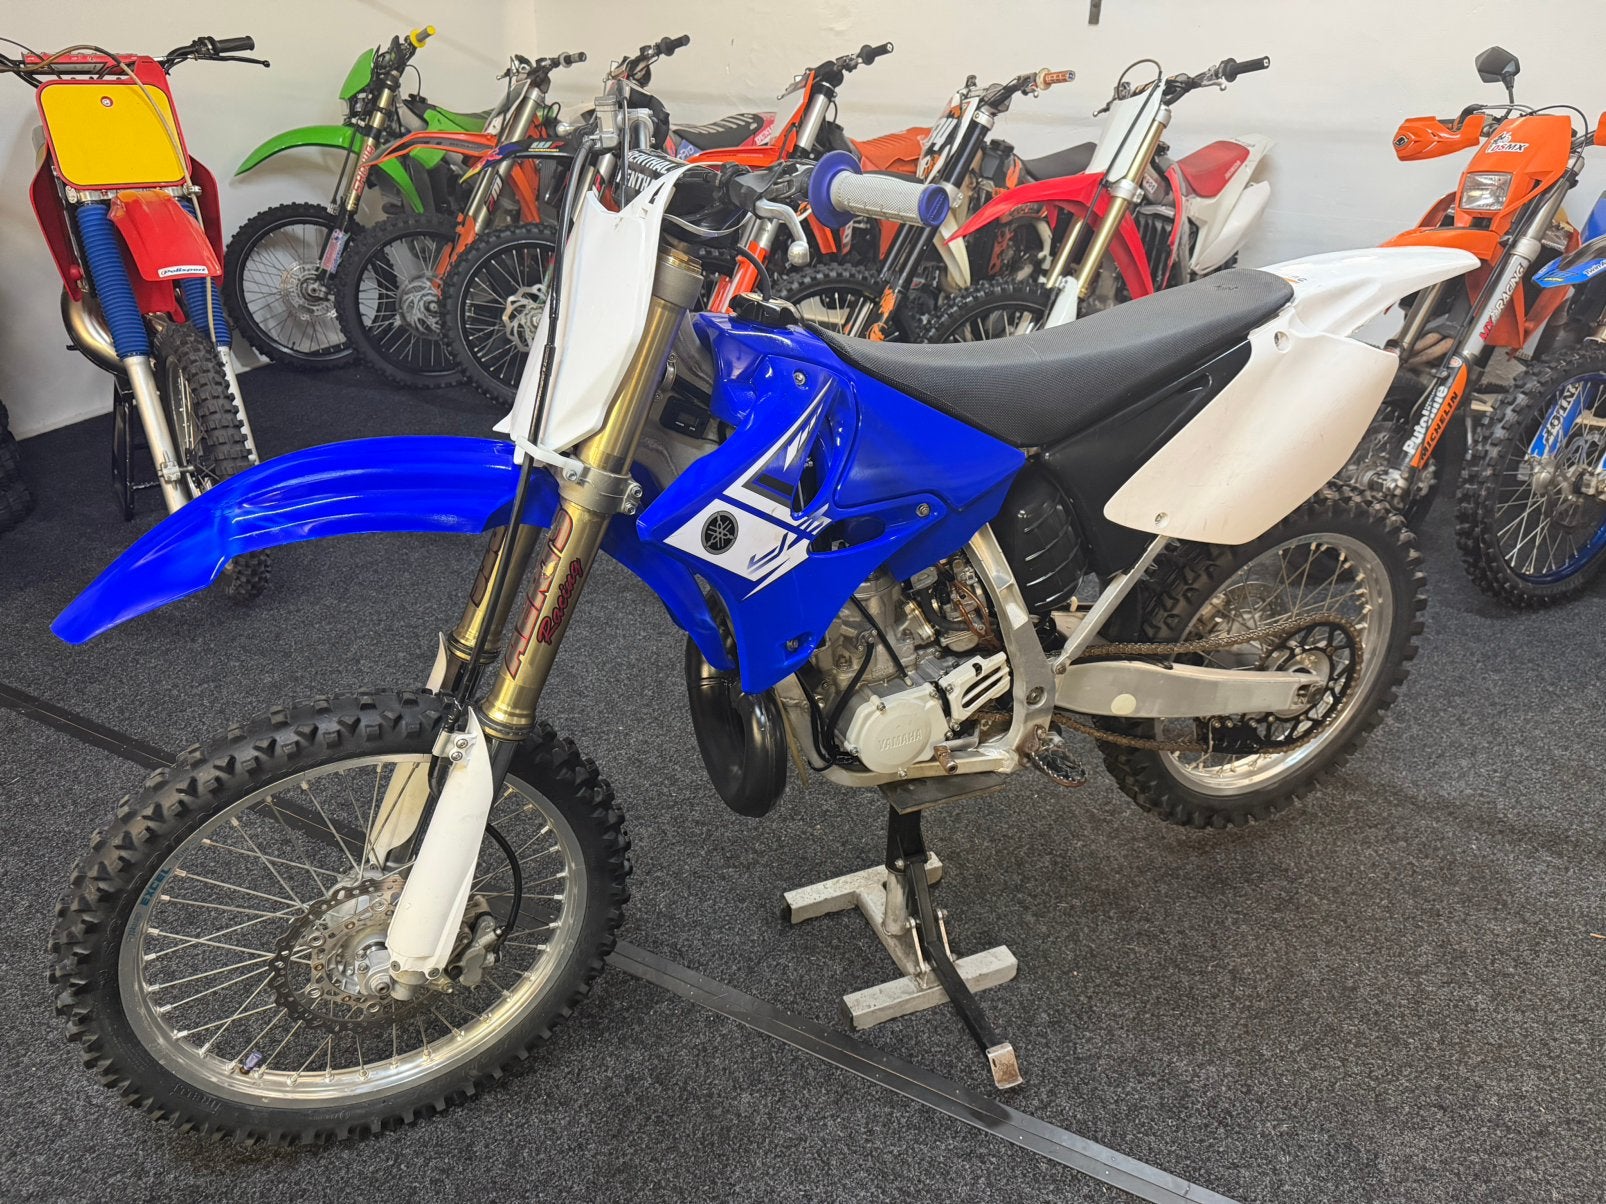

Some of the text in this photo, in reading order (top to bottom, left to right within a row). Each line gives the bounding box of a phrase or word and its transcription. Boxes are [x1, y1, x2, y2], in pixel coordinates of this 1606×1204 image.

[1495, 263, 1525, 311] RACING
[1421, 391, 1458, 460] MICHELIN
[536, 557, 584, 646] Racing
[880, 729, 923, 752] YAMAHA
[140, 866, 172, 907] EXCEL
